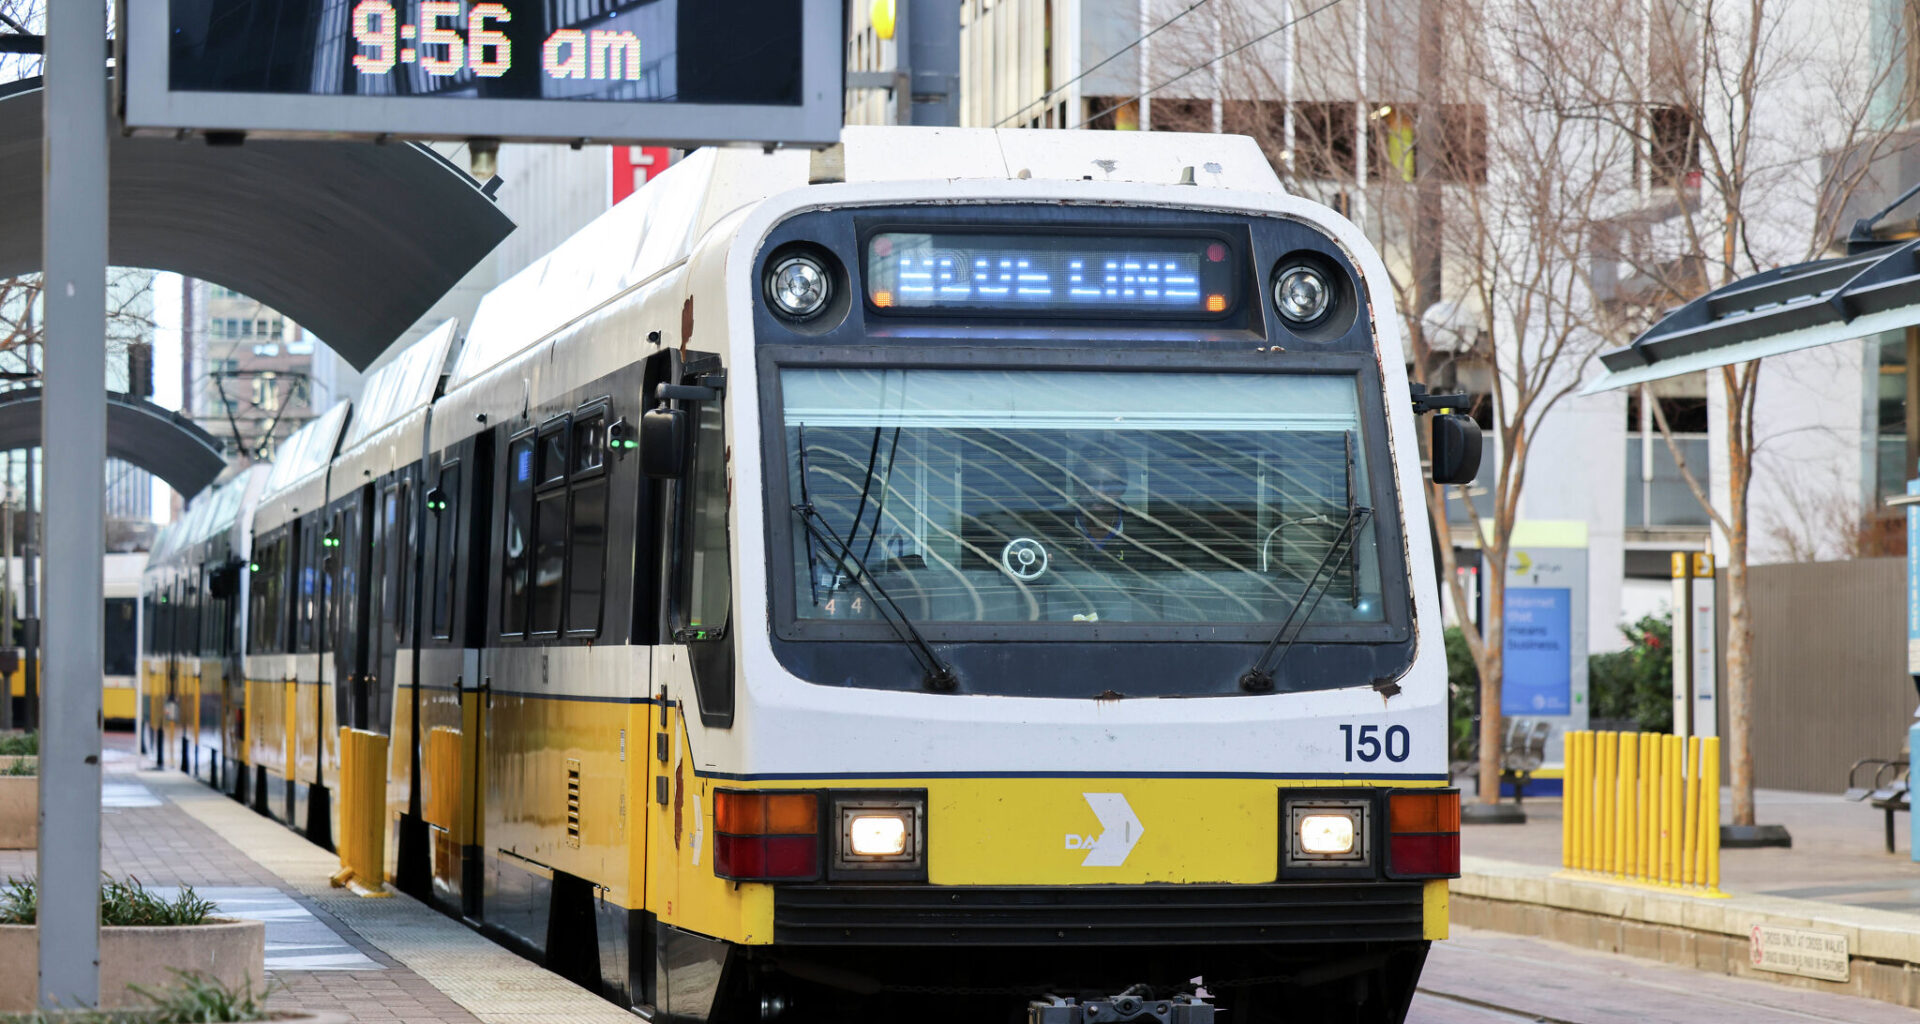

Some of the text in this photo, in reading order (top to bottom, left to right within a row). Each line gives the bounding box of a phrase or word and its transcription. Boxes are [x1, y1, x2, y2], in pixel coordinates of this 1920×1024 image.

[352, 0, 640, 80] 9:56 am
[1340, 724, 1410, 763] 150
